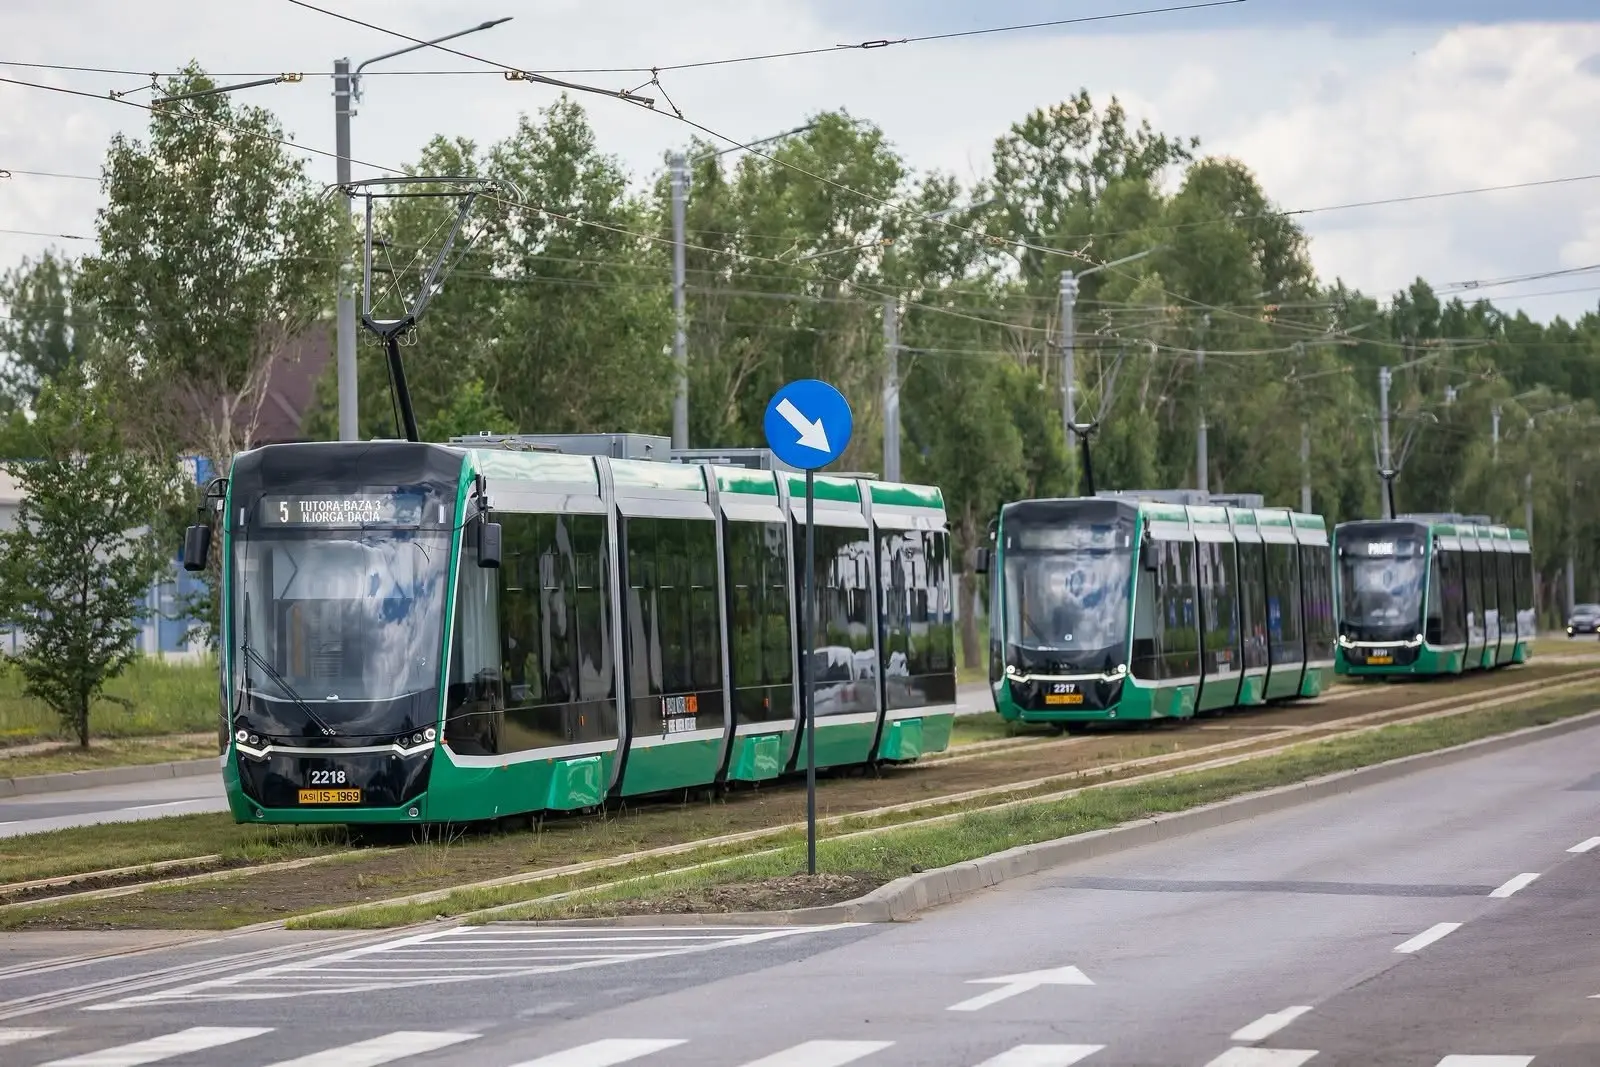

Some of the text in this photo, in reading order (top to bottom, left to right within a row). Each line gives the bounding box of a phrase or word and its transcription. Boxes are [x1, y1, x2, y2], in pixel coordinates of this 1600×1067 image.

[299, 500, 381, 512] TUTORA-BAZA 3
[280, 501, 289, 523] 5
[302, 511, 381, 522] N.IORGA-DACIA
[1053, 683, 1076, 693] 2217
[311, 770, 346, 784] 2218
[300, 791, 359, 802] IASI IS-1969
